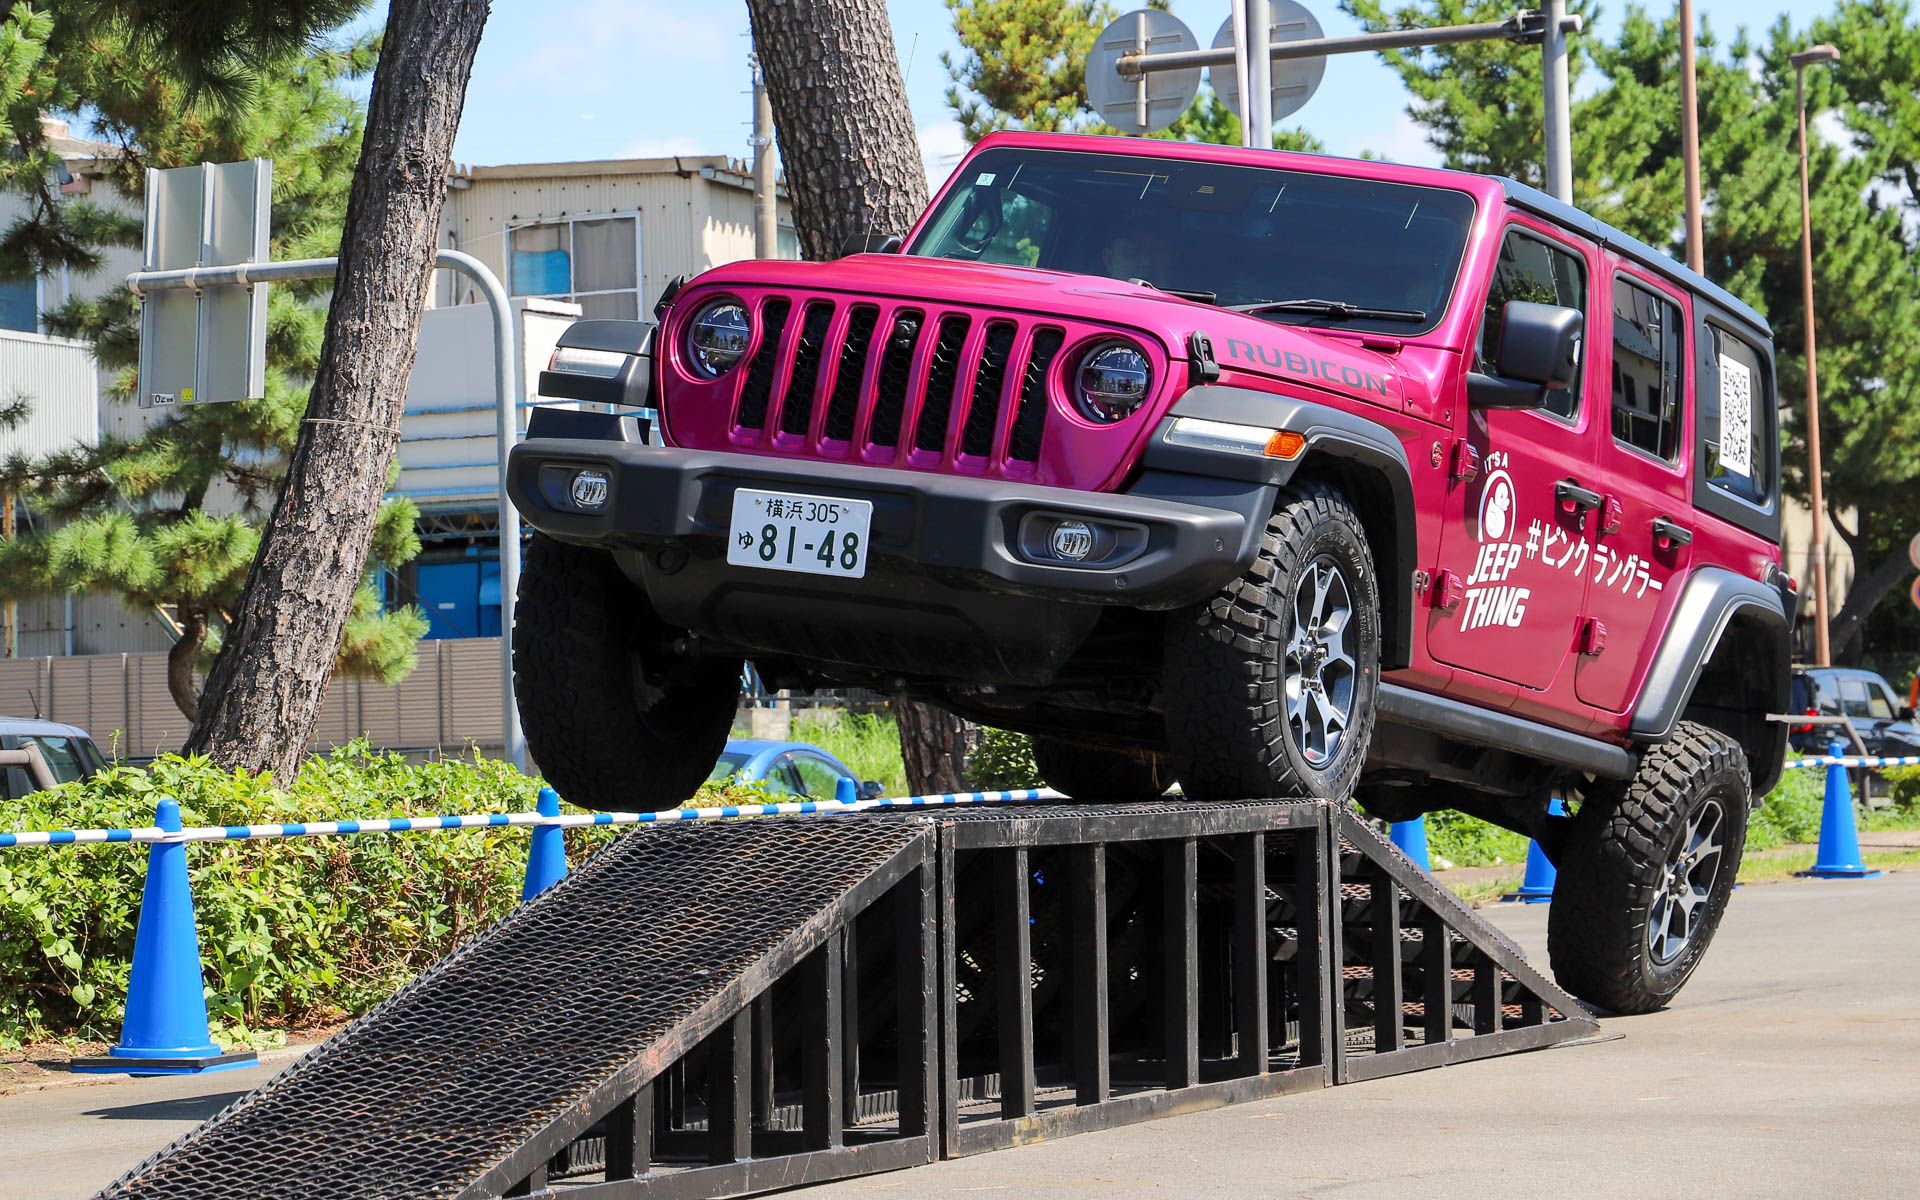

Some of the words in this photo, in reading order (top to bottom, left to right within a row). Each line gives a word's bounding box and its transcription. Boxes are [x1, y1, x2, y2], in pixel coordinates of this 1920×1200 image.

[1227, 338, 1387, 396] RUBICON
[1484, 450, 1501, 474] IT'S
[1501, 451, 1509, 469] A
[759, 523, 859, 570] 81-48
[1466, 542, 1522, 586] JEEP
[1459, 585, 1531, 633] THING
